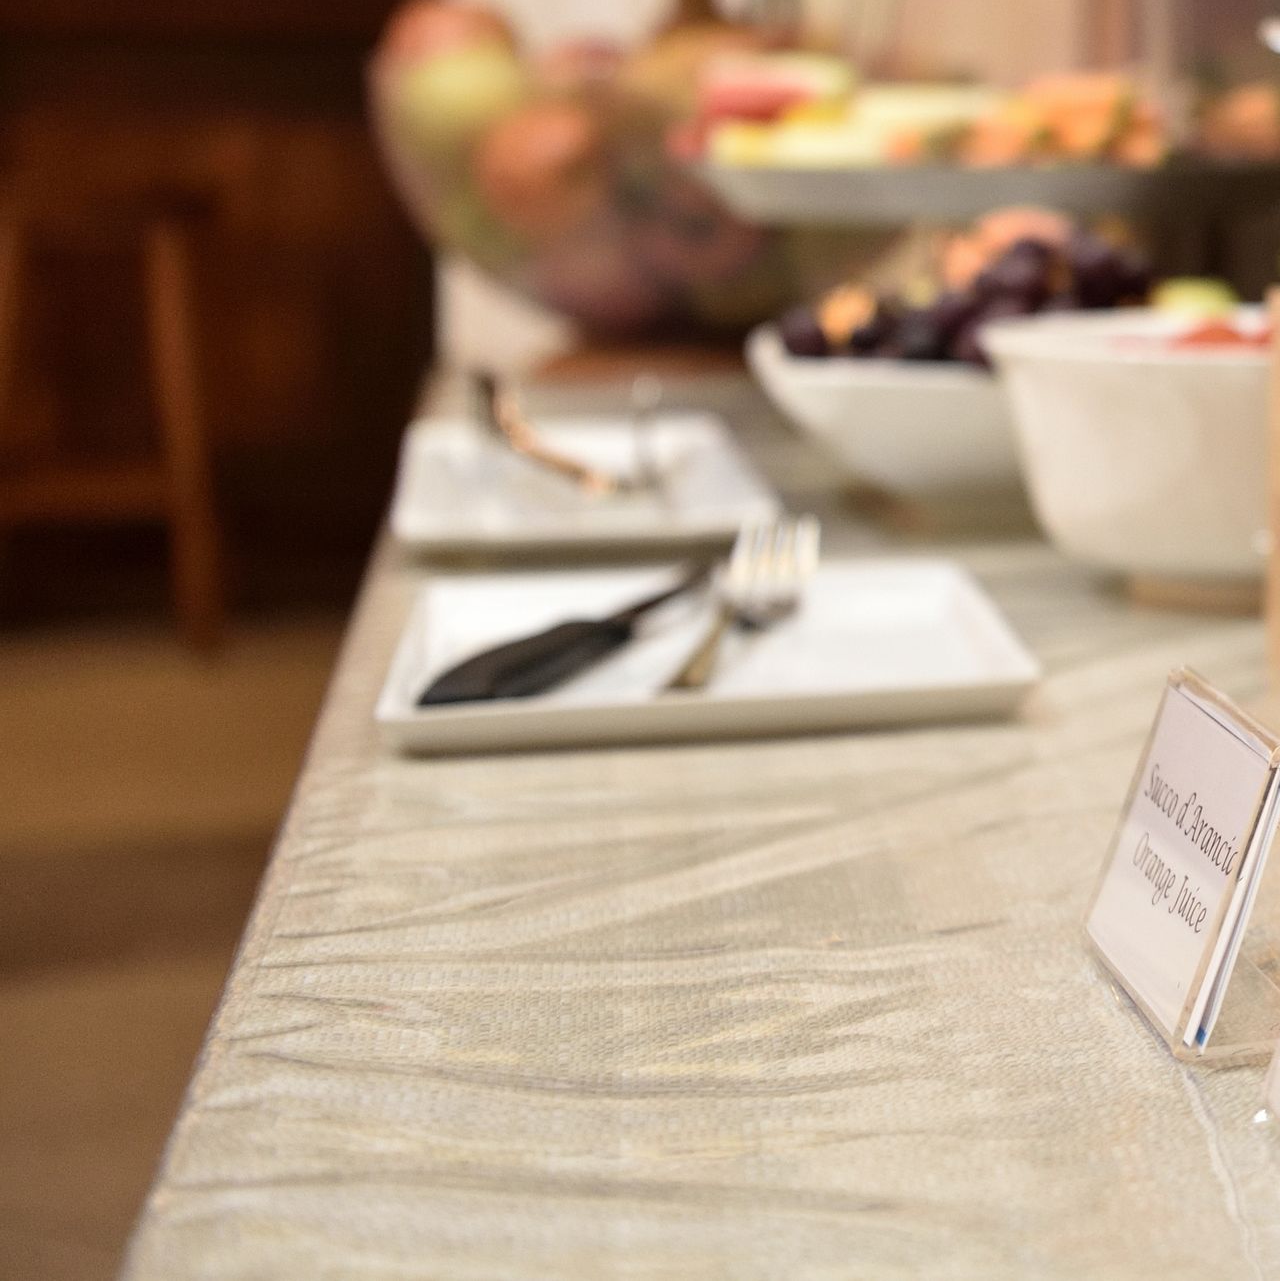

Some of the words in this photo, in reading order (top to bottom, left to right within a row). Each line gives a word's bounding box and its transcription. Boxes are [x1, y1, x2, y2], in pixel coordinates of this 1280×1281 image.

[1144, 763, 1179, 818] Succo
[1132, 831, 1176, 906] Orange
[1168, 874, 1207, 934] Juice
